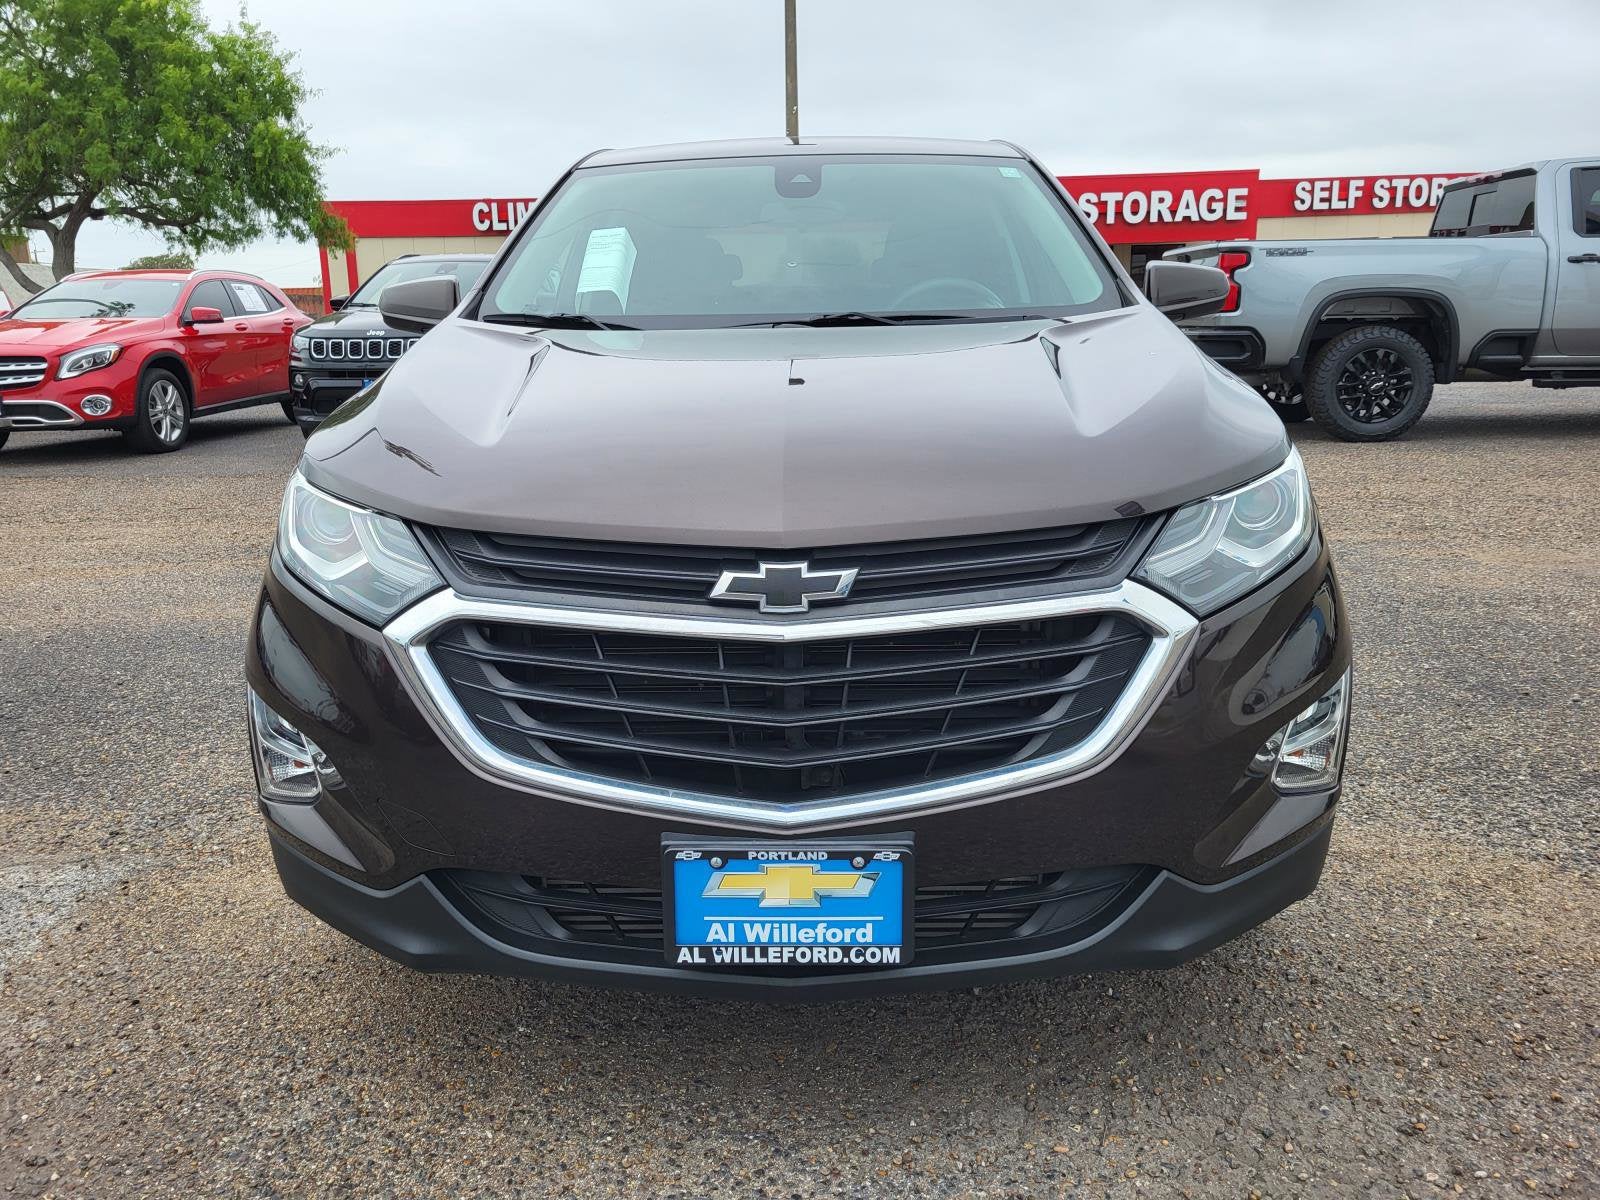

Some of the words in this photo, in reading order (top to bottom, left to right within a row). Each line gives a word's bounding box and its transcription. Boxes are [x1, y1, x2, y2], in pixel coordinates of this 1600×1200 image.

[1294, 179, 1364, 211] SELF
[1078, 188, 1248, 225] STORAGE
[748, 851, 828, 861] PORTLAND
[706, 923, 735, 943] Al
[743, 922, 873, 943] Willeford
[677, 947, 706, 963] AL
[712, 946, 900, 963] WILLEFORD.COM
